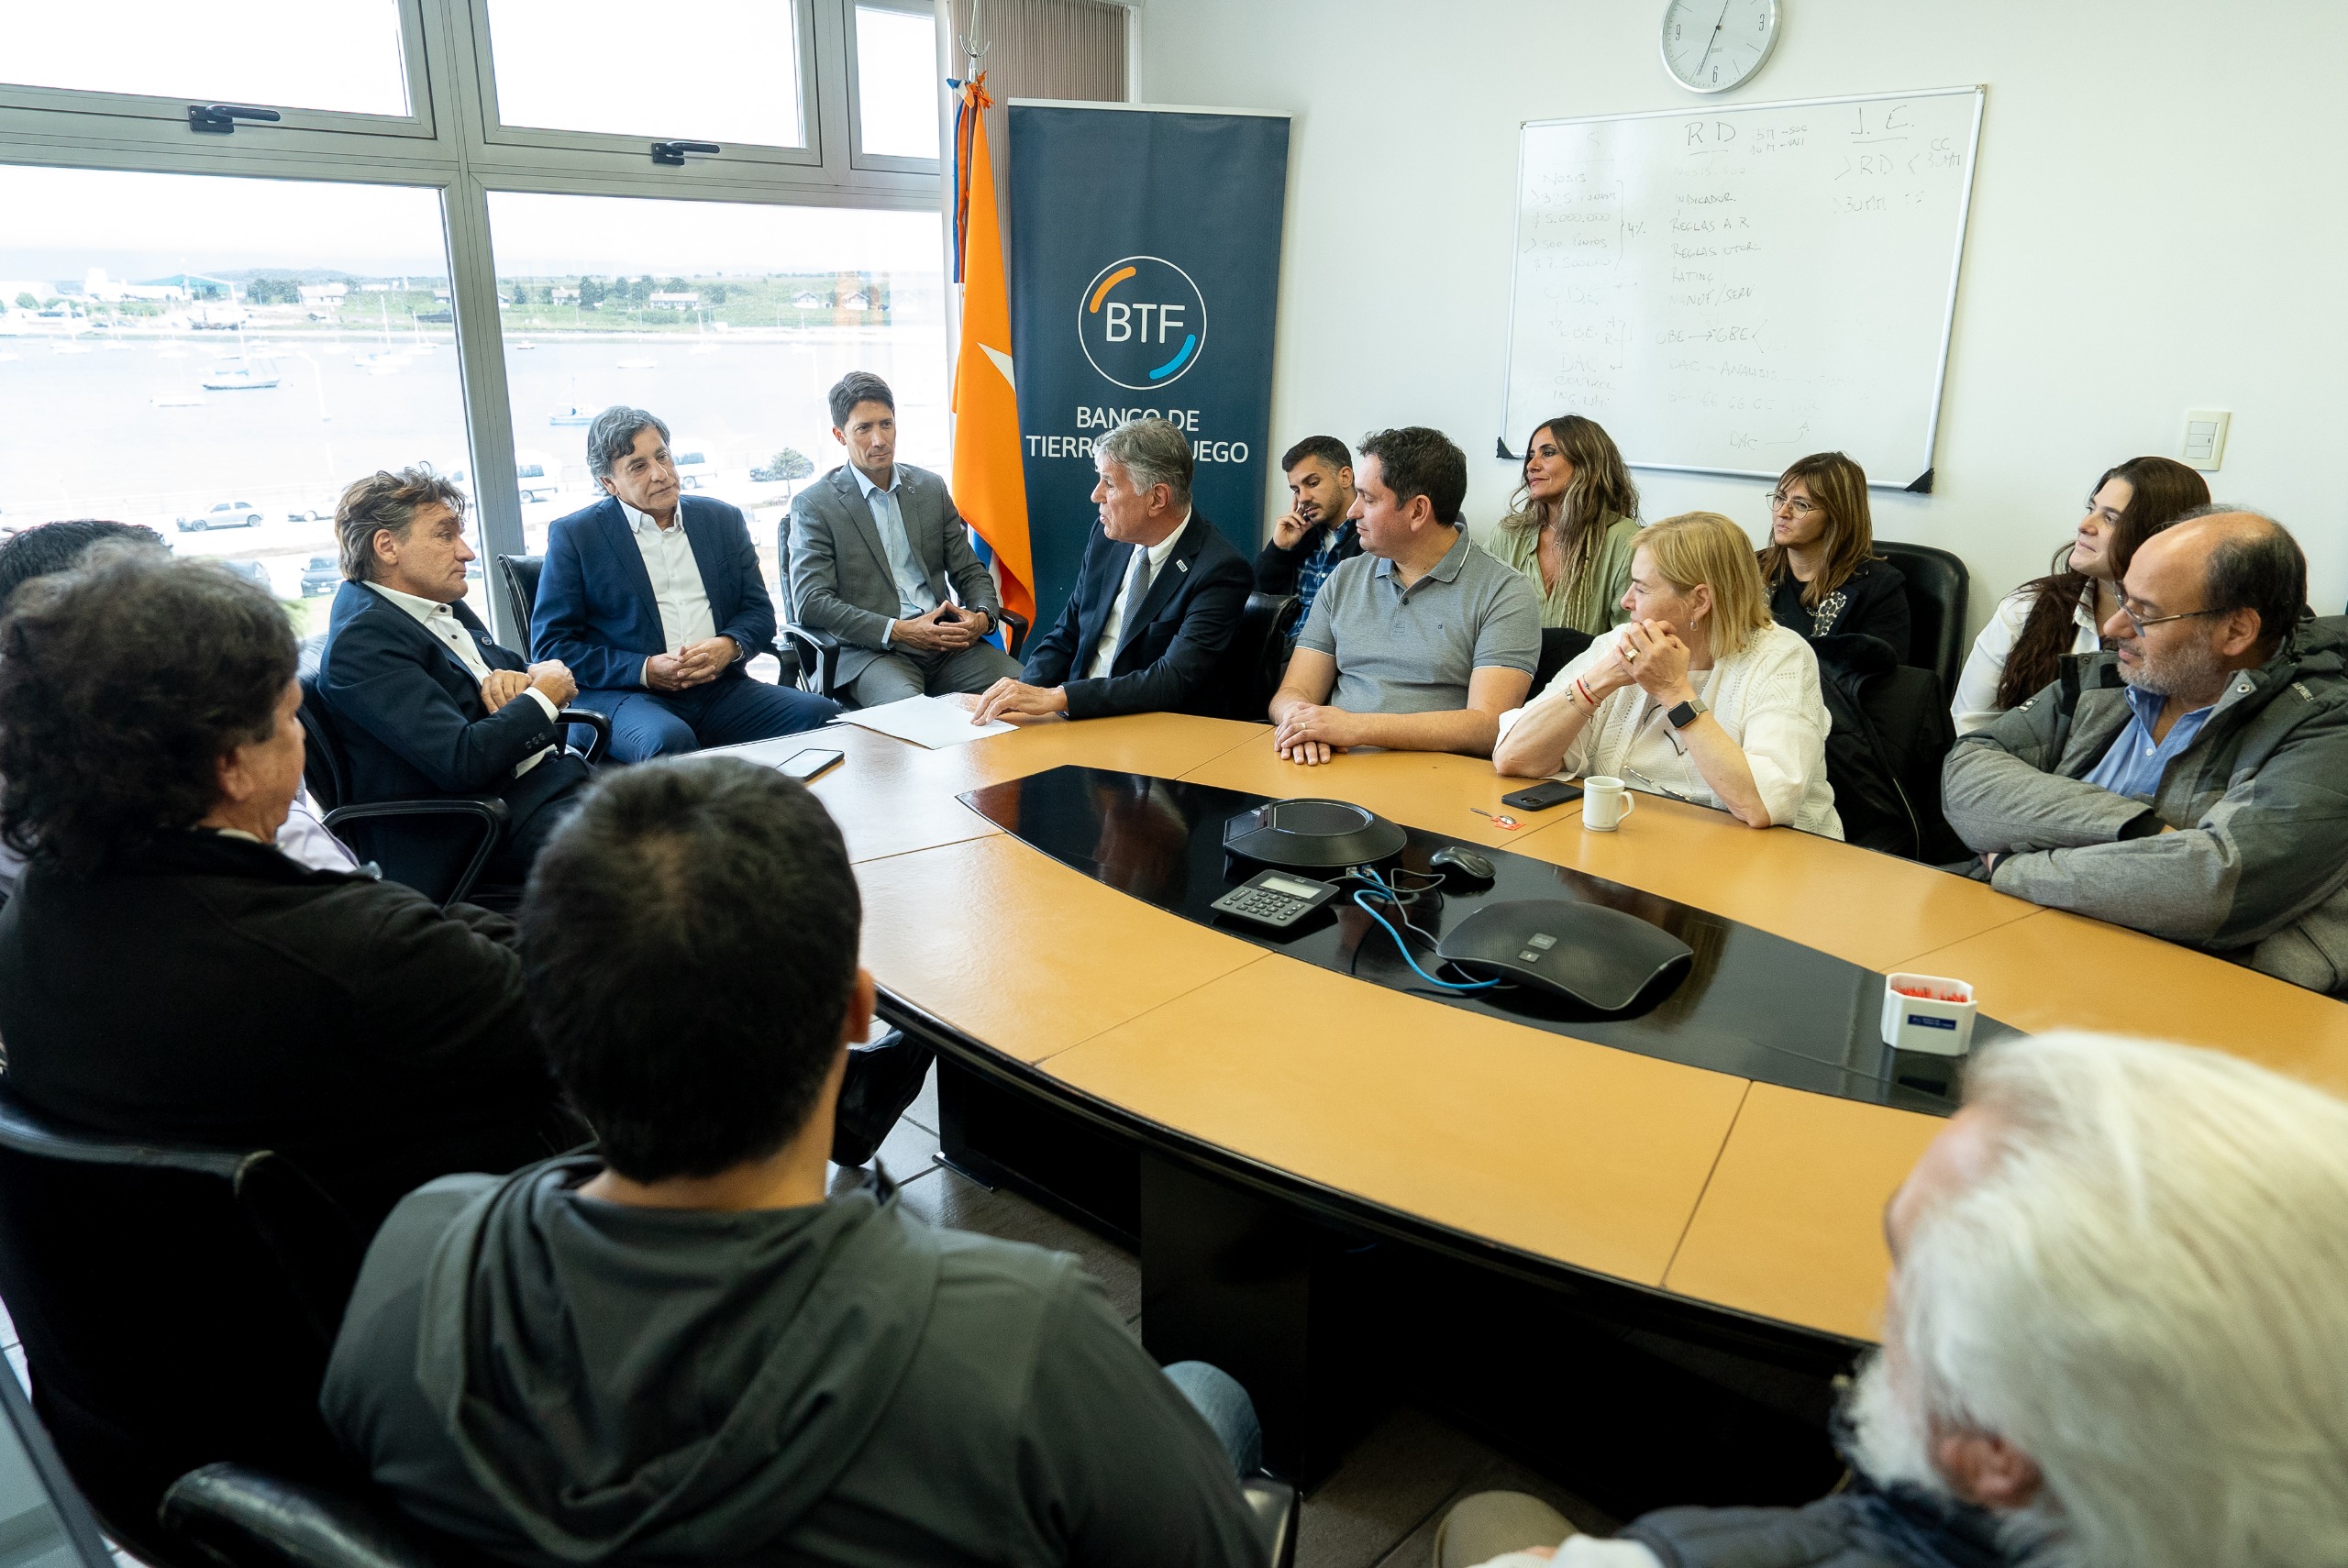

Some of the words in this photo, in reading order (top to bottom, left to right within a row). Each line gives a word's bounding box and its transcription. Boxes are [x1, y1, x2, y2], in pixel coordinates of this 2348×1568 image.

[1676, 24, 1681, 41] 9
[1758, 13, 1766, 32] 3
[1712, 65, 1719, 83] 6
[1106, 303, 1186, 343] BTF
[1168, 409, 1200, 432] DE
[1025, 435, 1094, 458] TIERR
